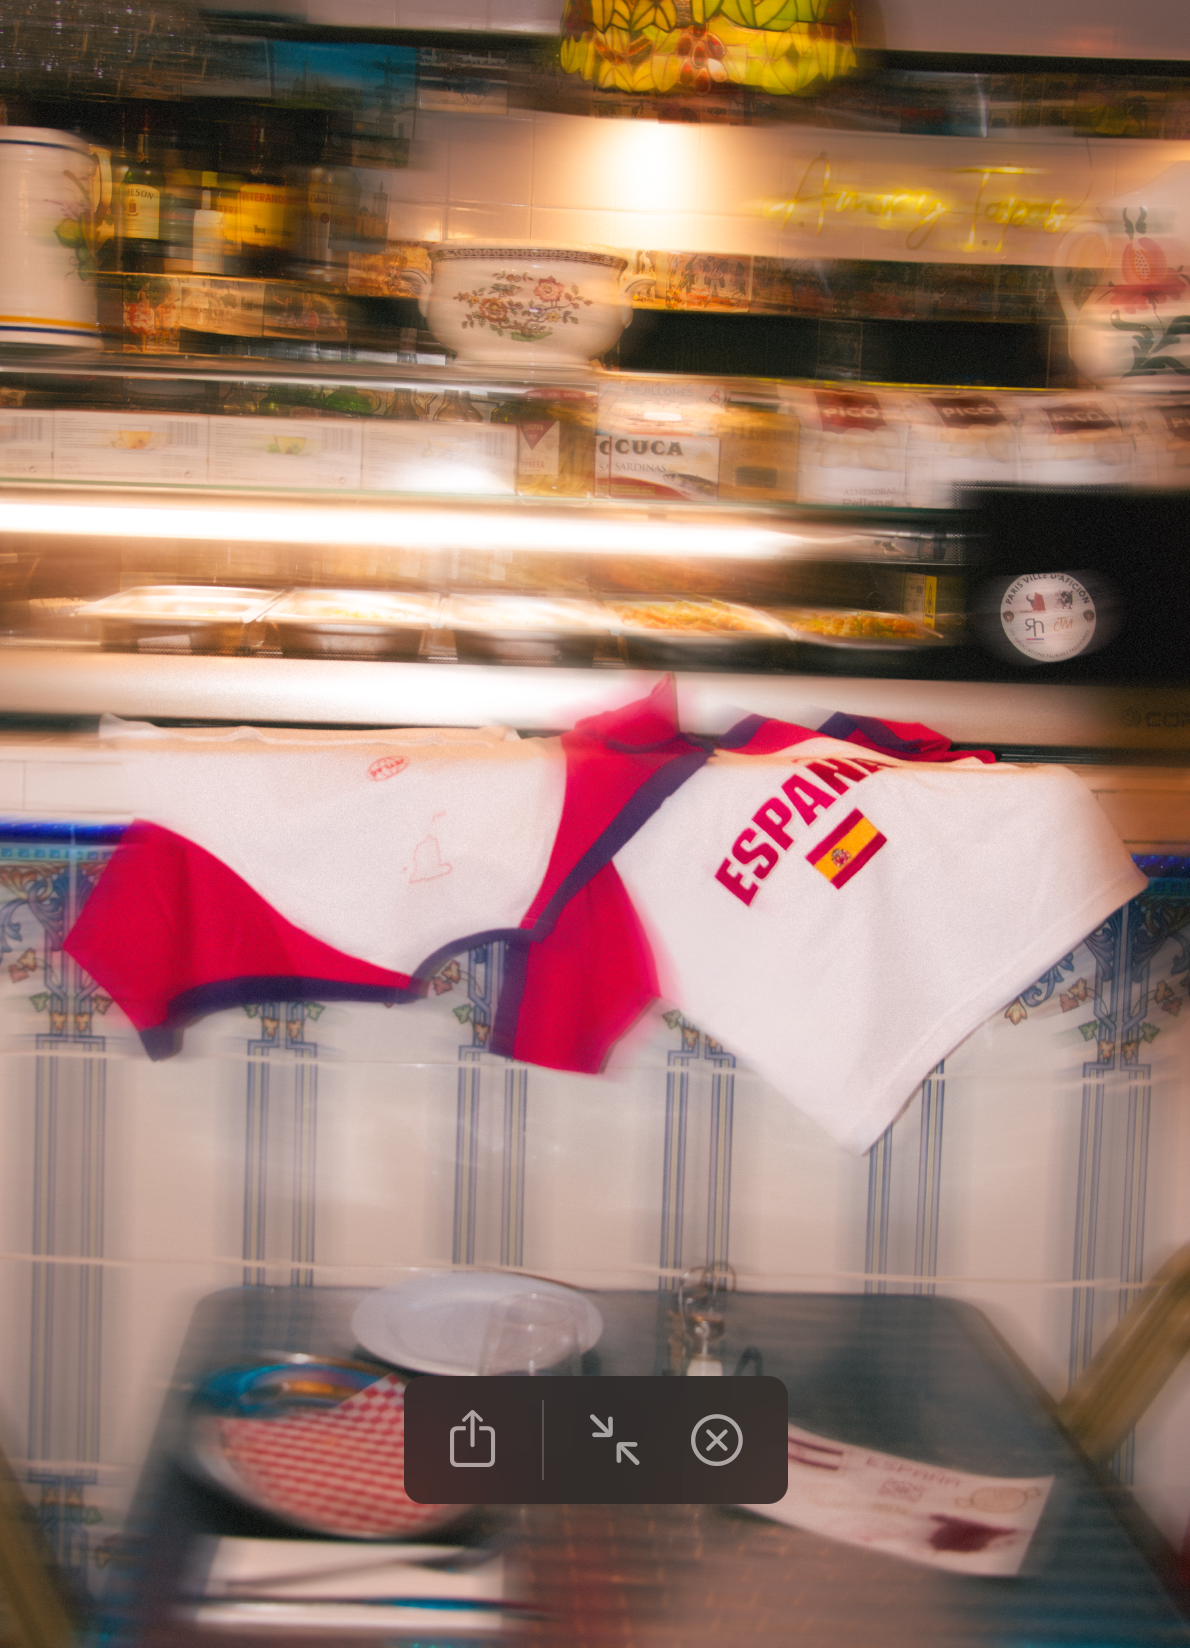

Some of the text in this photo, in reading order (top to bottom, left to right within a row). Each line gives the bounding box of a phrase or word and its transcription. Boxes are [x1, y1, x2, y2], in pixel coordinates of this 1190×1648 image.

[123, 188, 154, 200] MESON
[624, 386, 695, 397] MEJILLONES
[615, 438, 684, 456] CUCA
[615, 463, 668, 473] SARDINAS
[843, 487, 897, 497] ALMENDRAS
[1005, 581, 1023, 605] PARIS
[1022, 573, 1047, 584] VILLE
